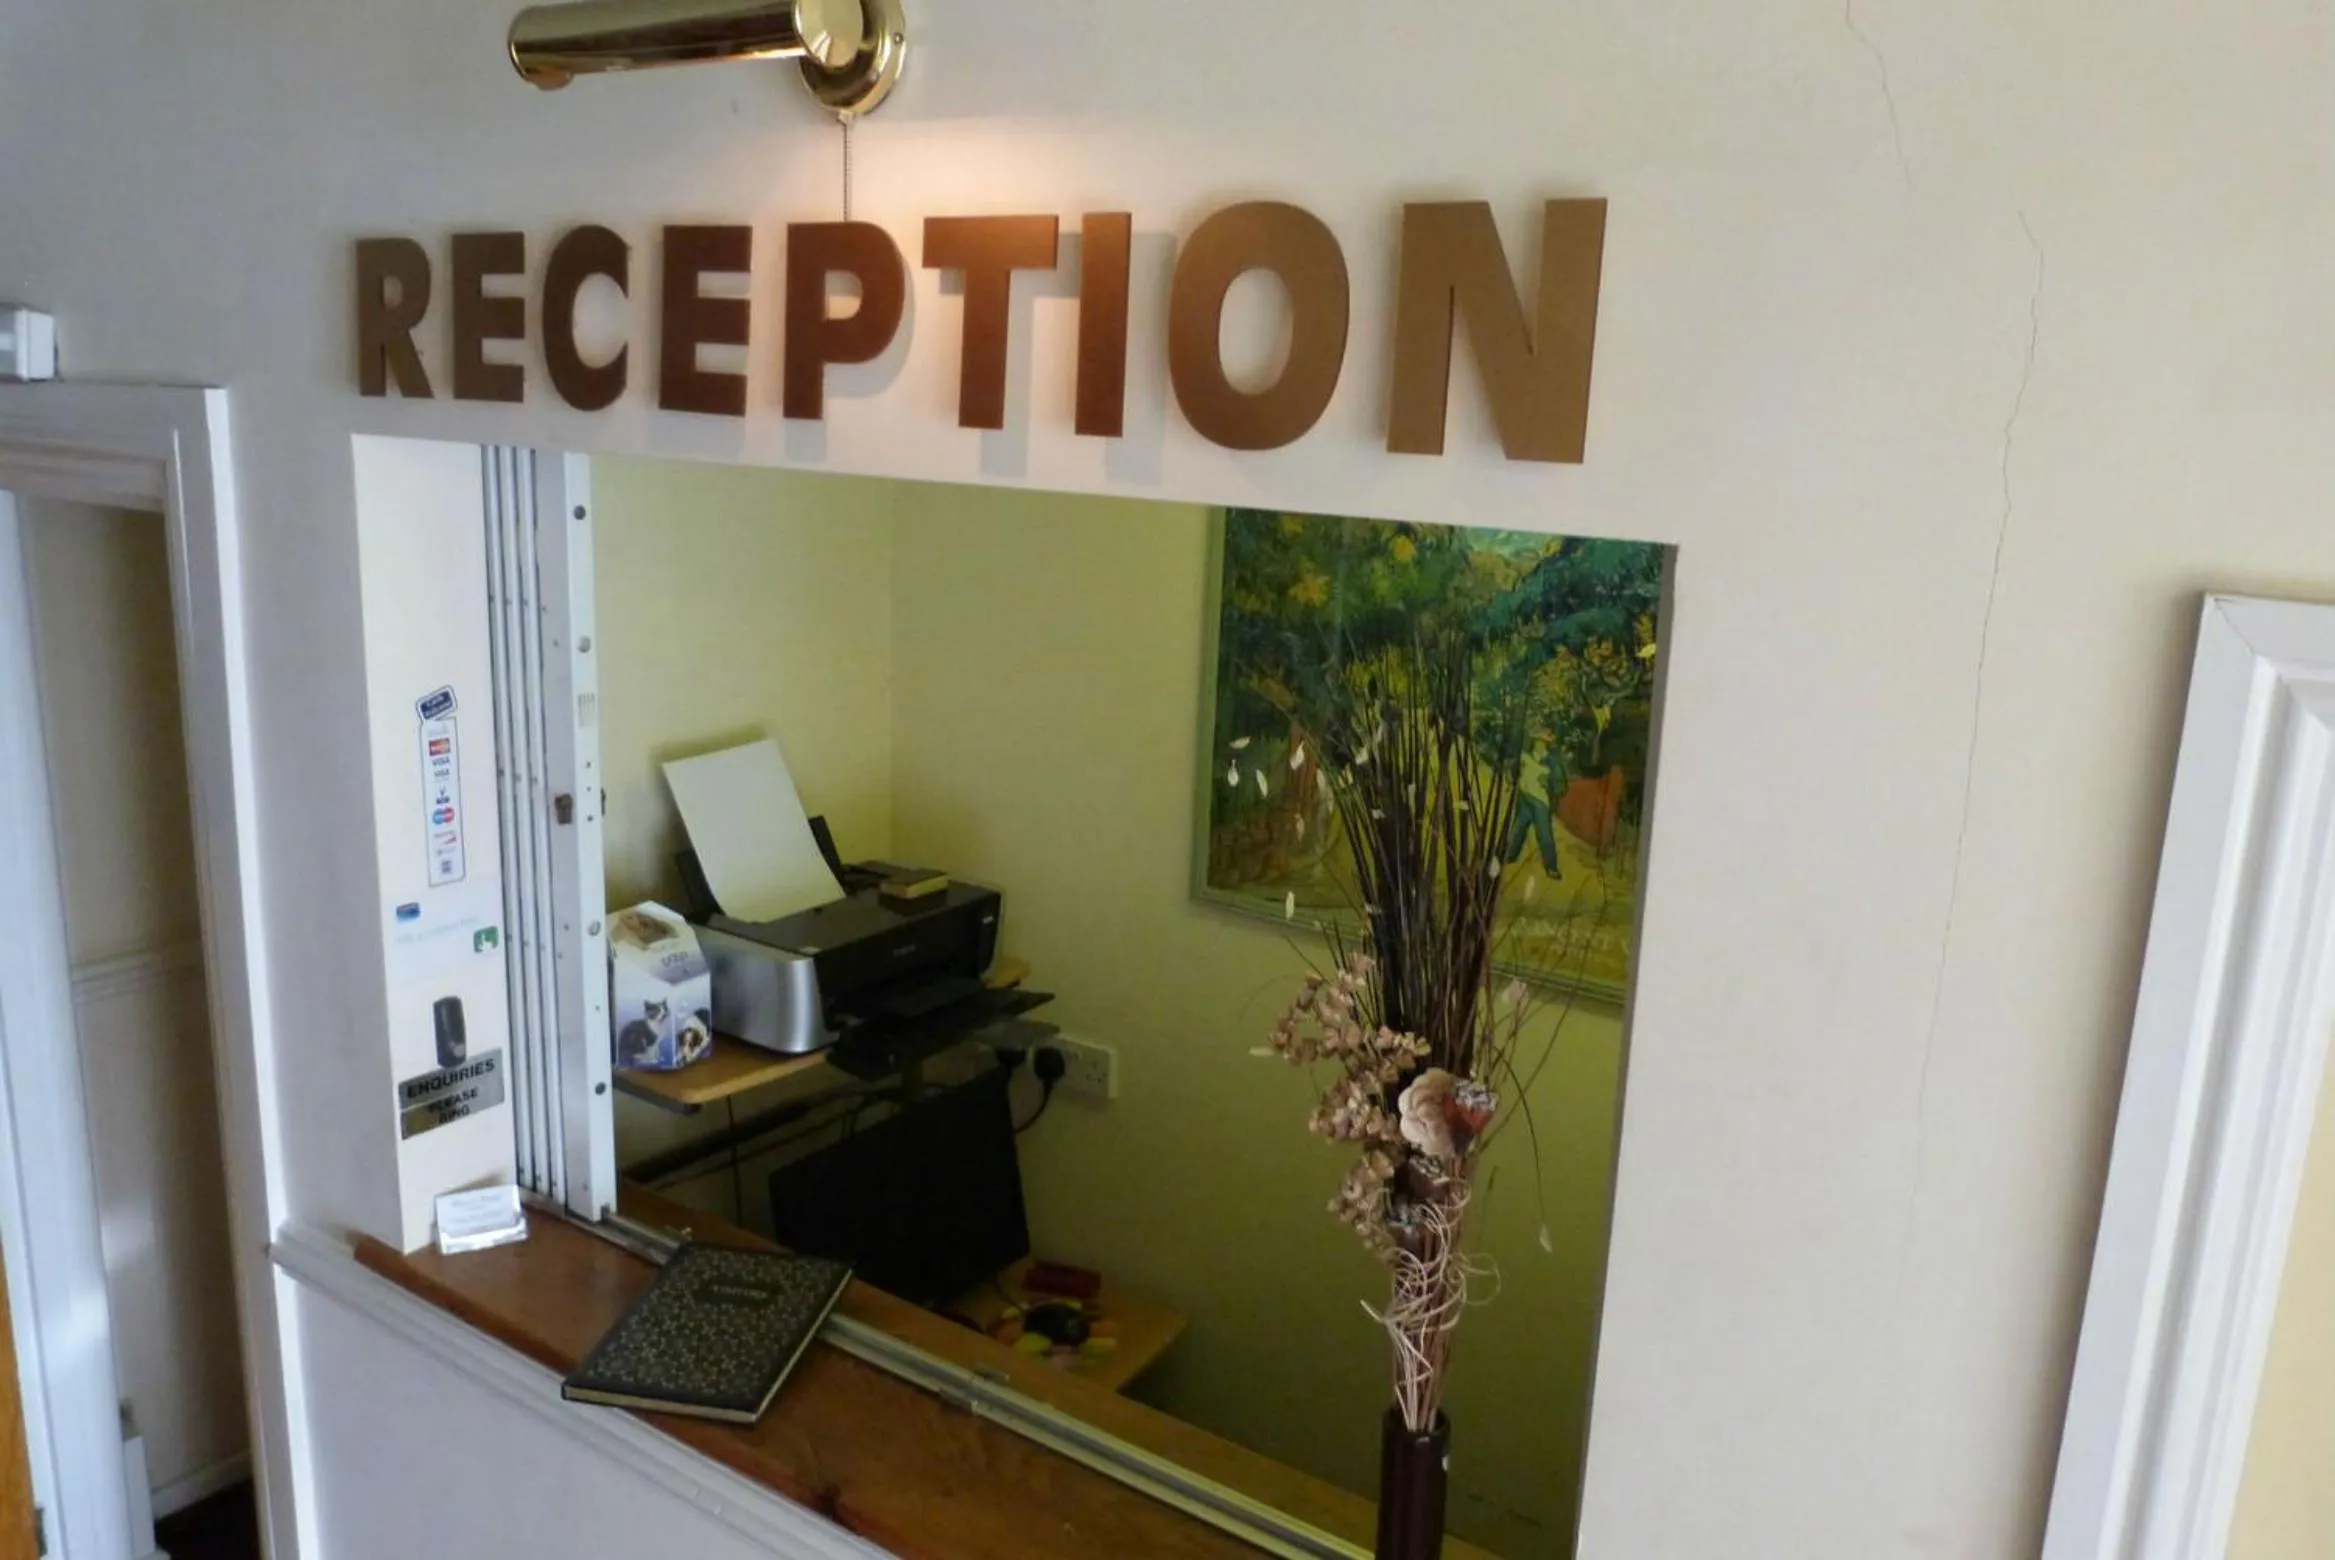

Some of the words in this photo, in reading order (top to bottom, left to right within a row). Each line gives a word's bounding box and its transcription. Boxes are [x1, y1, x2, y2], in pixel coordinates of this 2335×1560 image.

[354, 197, 1608, 464] RECEPTION
[406, 1058, 495, 1099] ENQUIRIES
[428, 1085, 479, 1114] PLEASE
[438, 1103, 471, 1126] RING
